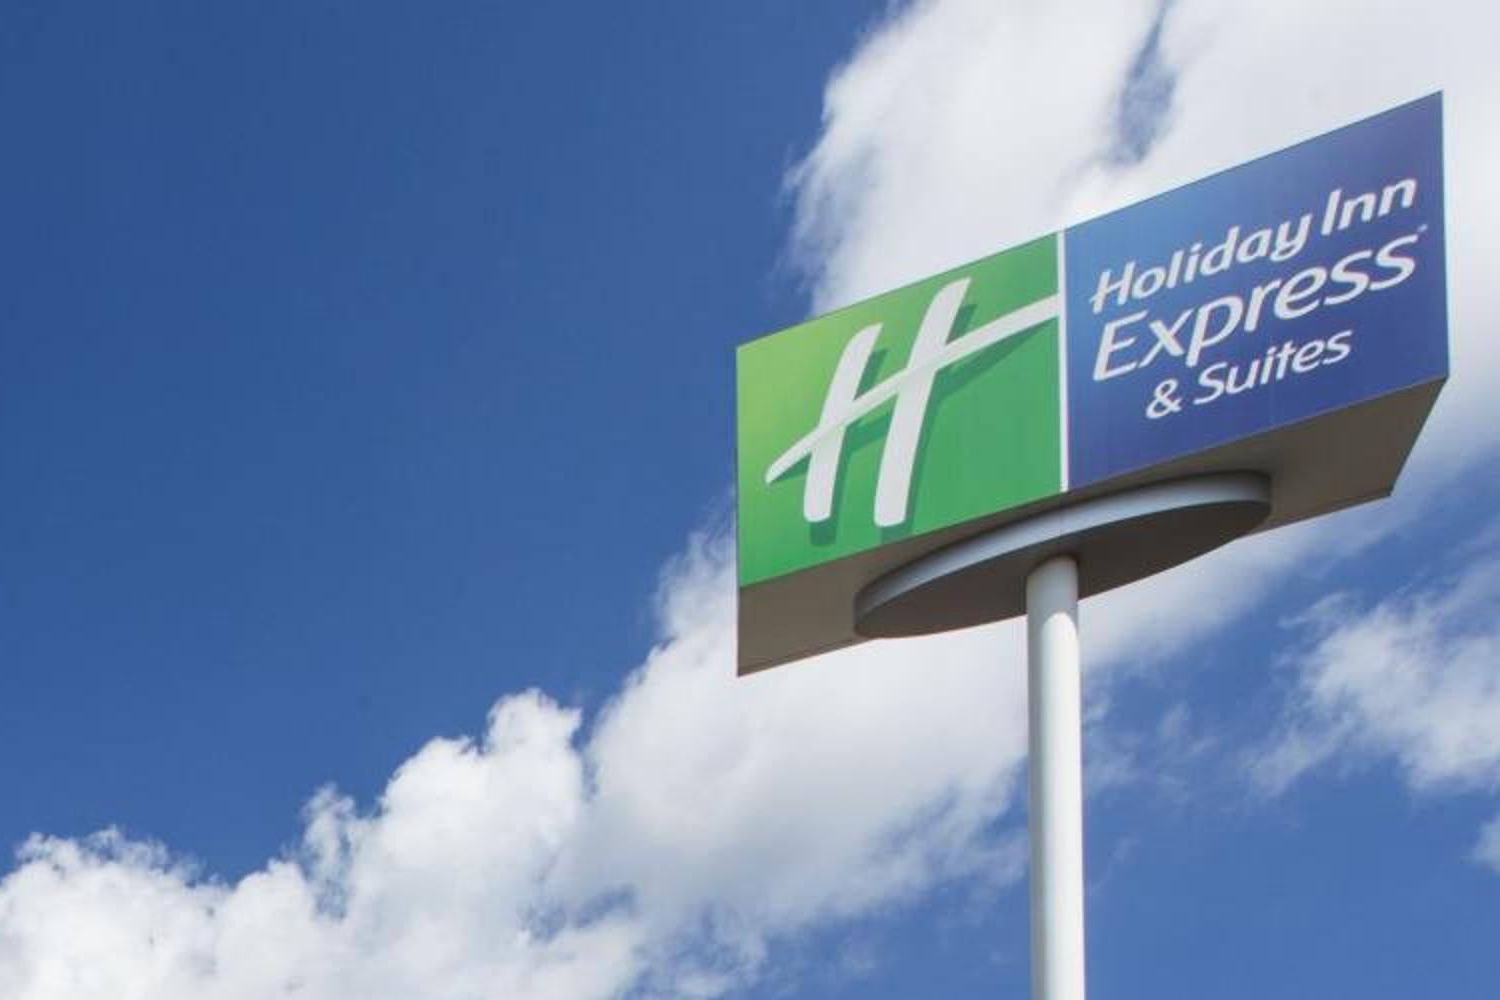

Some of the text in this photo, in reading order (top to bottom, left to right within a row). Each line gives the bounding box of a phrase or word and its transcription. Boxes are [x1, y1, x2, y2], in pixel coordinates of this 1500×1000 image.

[1090, 178, 1417, 313] Holiday Inn
[1093, 234, 1418, 381] Express
[766, 278, 1060, 526] H
[1146, 330, 1352, 419] & Suites
